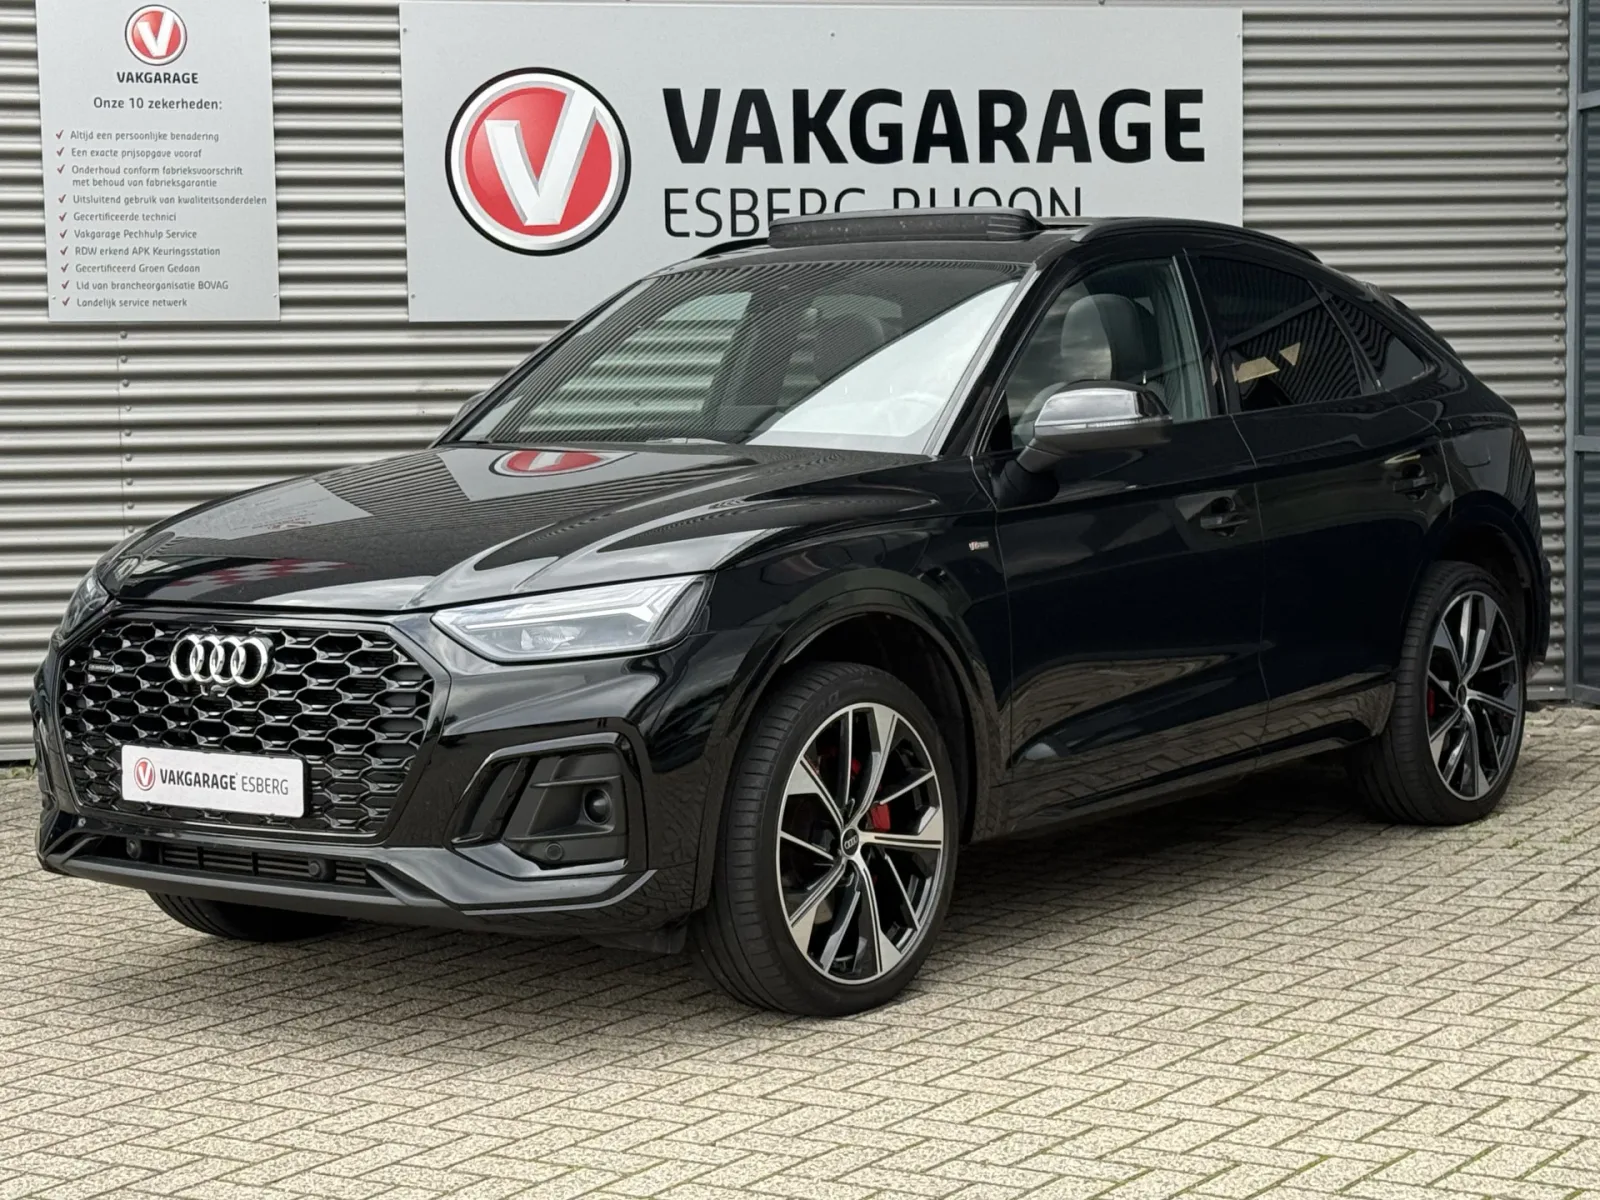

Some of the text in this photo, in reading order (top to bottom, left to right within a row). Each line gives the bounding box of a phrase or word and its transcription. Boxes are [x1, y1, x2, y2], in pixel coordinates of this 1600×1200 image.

[116, 71, 199, 85] VAKGARAGE
[93, 96, 222, 110] Onze 10 zekerheden:
[663, 88, 1204, 164] VAKGARAGE
[69, 130, 220, 143] Altijd een persoonlijke benadering
[71, 147, 88, 158] Een
[89, 149, 119, 158] exacte
[173, 148, 202, 158] vooraf
[71, 164, 243, 176] Onderhoud conform fabrieksvoorschrift
[72, 177, 218, 189] met behoud van fabrieksgarantie
[72, 194, 267, 206] Uitsluitend gebruik van kwaliteitsonderdelen
[73, 211, 177, 222] Gecertificeerde technici
[73, 228, 198, 241] Vakgarage Pechhulp Service
[74, 246, 221, 258] RDW erkend APK Keuringsstation
[75, 263, 201, 273] Gecertificeerd Groen Gedaan
[75, 280, 229, 292] Lid van brancheorganisatie BOVAG
[76, 297, 188, 309] Landelijk service netwerk
[159, 768, 289, 796] VAKGARAGE ESBERG
